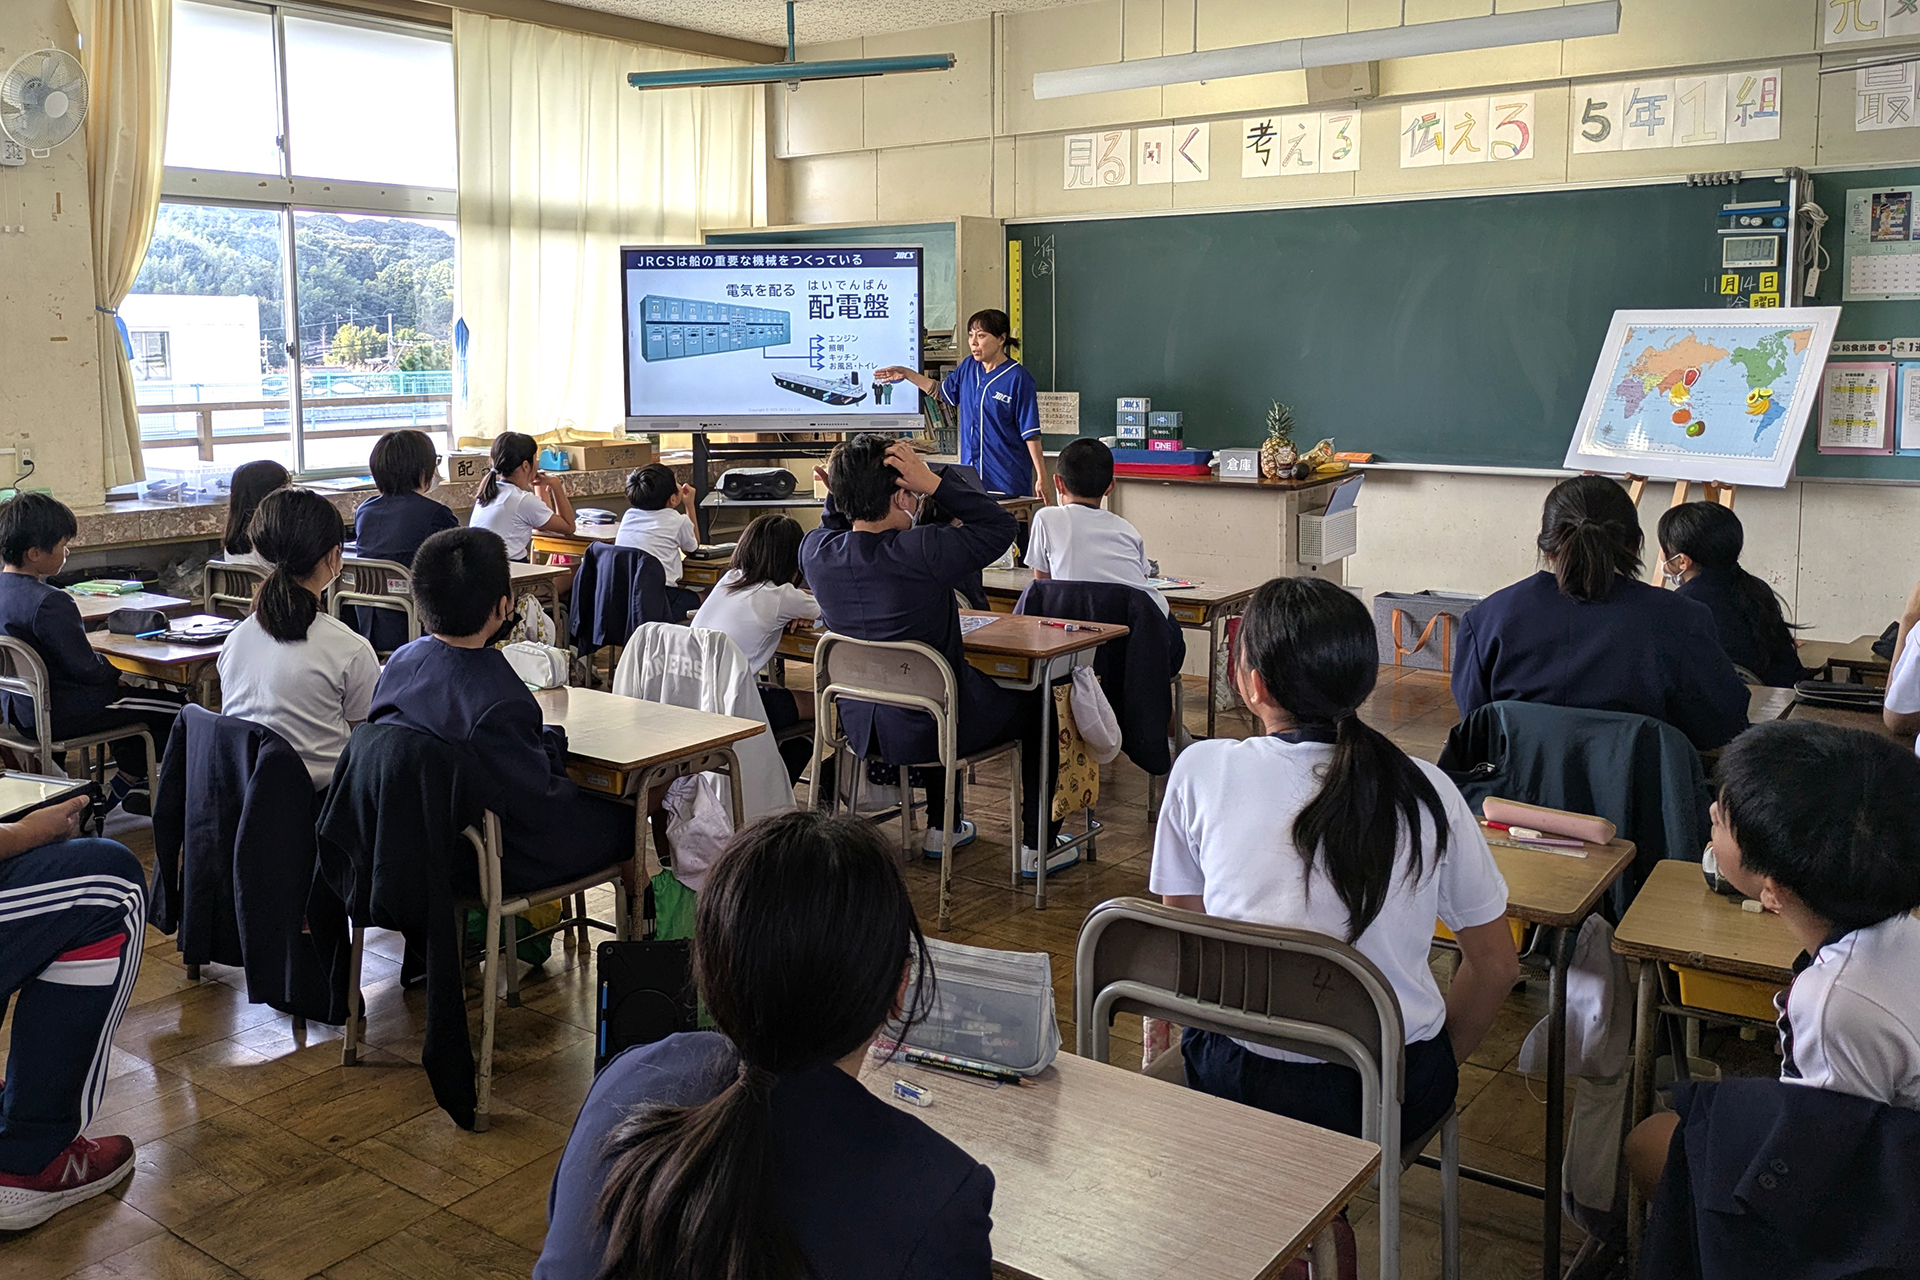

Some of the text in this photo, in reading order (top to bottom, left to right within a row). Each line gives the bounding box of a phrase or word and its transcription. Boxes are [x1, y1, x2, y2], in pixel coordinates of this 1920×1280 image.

[1858, 62, 1920, 124] 最
[1581, 75, 1779, 143] 5年1組
[1246, 115, 1353, 167] 考える
[1402, 102, 1531, 161] 伝える
[1068, 131, 1126, 187] 見る
[1143, 127, 1202, 173] 聞く
[637, 254, 863, 267] JRCSは船の重要な機械をつくっている
[726, 283, 796, 298] 電気を配る
[808, 279, 888, 291] はいでんばん
[808, 293, 890, 320] 配電盤
[829, 344, 845, 352] 照明
[1842, 343, 1876, 352] 給食当番
[829, 362, 878, 370] お風呂・トイレ
[1227, 457, 1252, 472] 倉庫
[645, 653, 703, 681] NERS
[900, 662, 911, 675] 4
[1312, 966, 1335, 1003] 4
